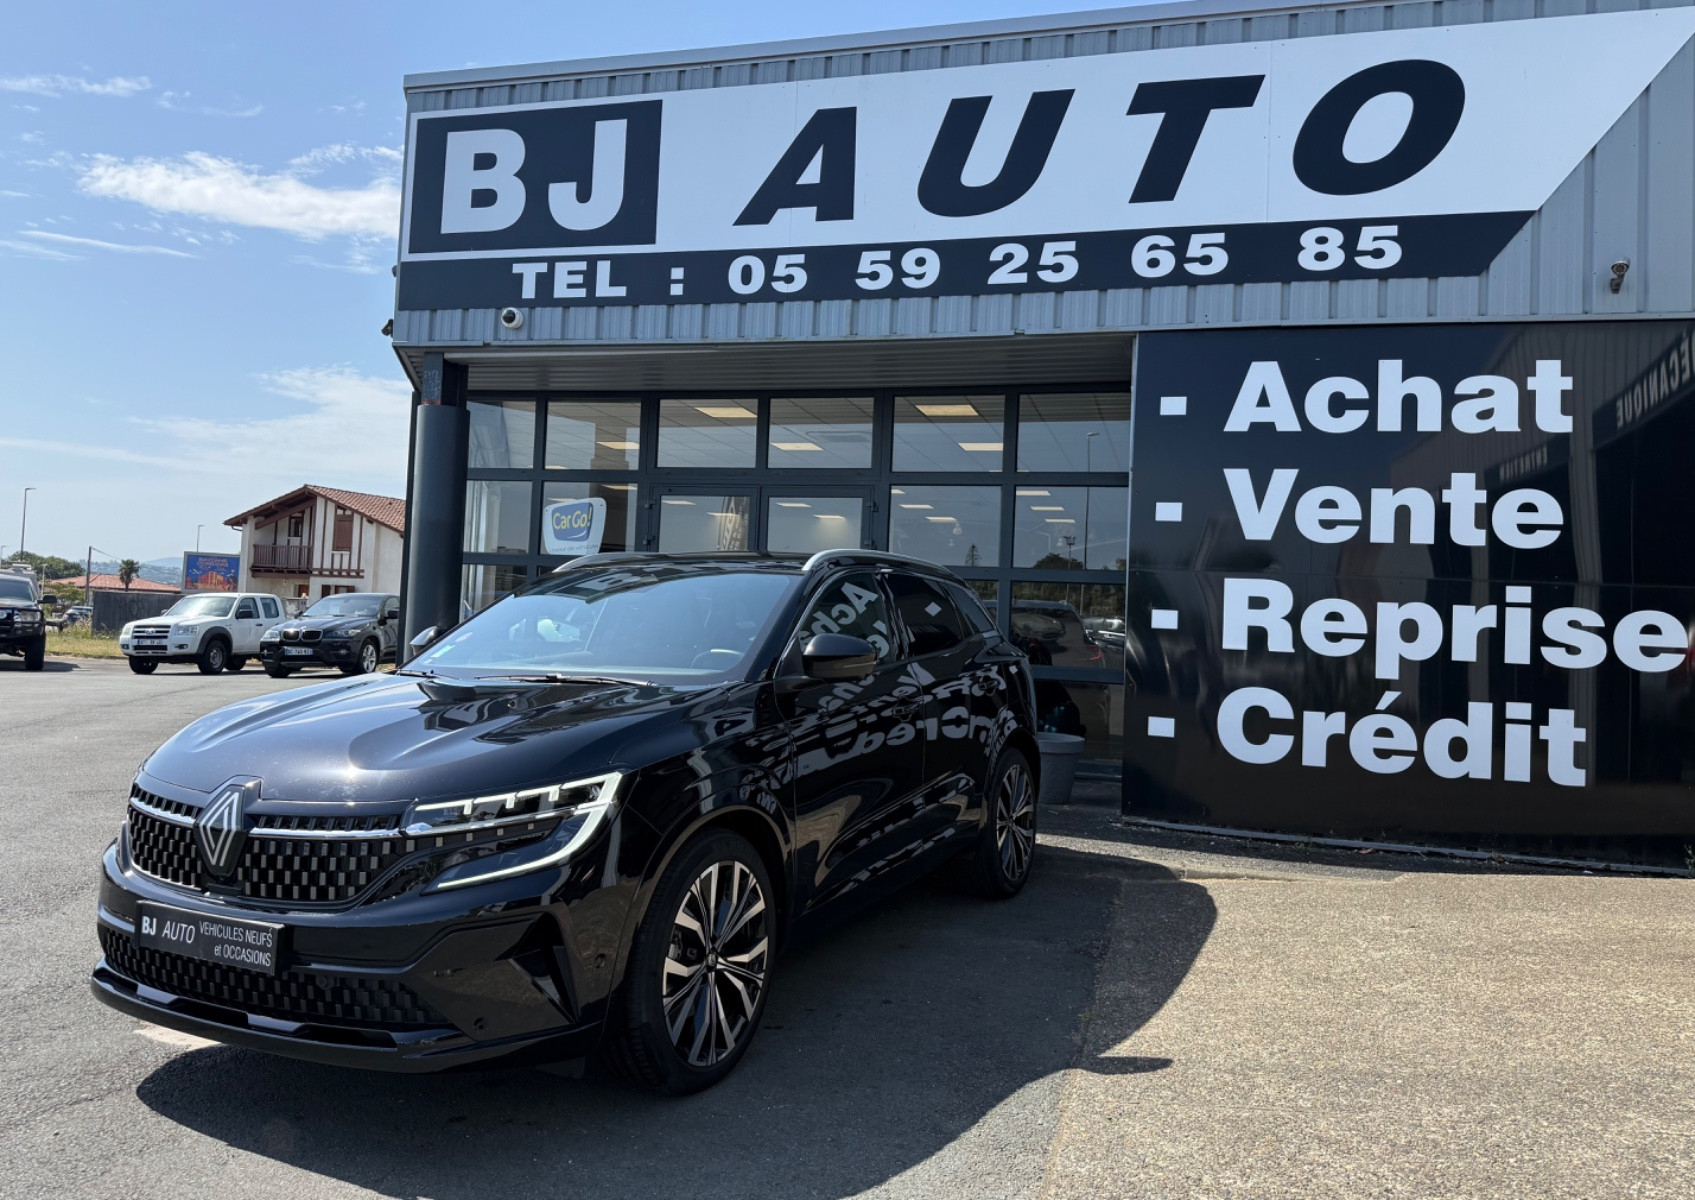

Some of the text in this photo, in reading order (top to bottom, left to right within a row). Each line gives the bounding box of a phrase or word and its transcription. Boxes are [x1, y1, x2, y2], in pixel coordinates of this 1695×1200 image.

[441, 60, 1465, 233] BJ AUTO
[513, 262, 626, 298] TEL
[728, 254, 807, 295] 05
[855, 248, 940, 290] 59
[987, 241, 1078, 285] 25
[1131, 232, 1229, 278] 65
[1298, 226, 1402, 271] 85
[1224, 360, 1573, 433] Achat
[1224, 469, 1564, 549] Vente
[1223, 578, 1689, 680] Reprise
[1217, 687, 1587, 787] Crédit
[141, 915, 196, 944] BJ AUTO
[199, 921, 273, 948] VEHICULES NEUFS
[214, 944, 272, 967] et OCCASIONS
